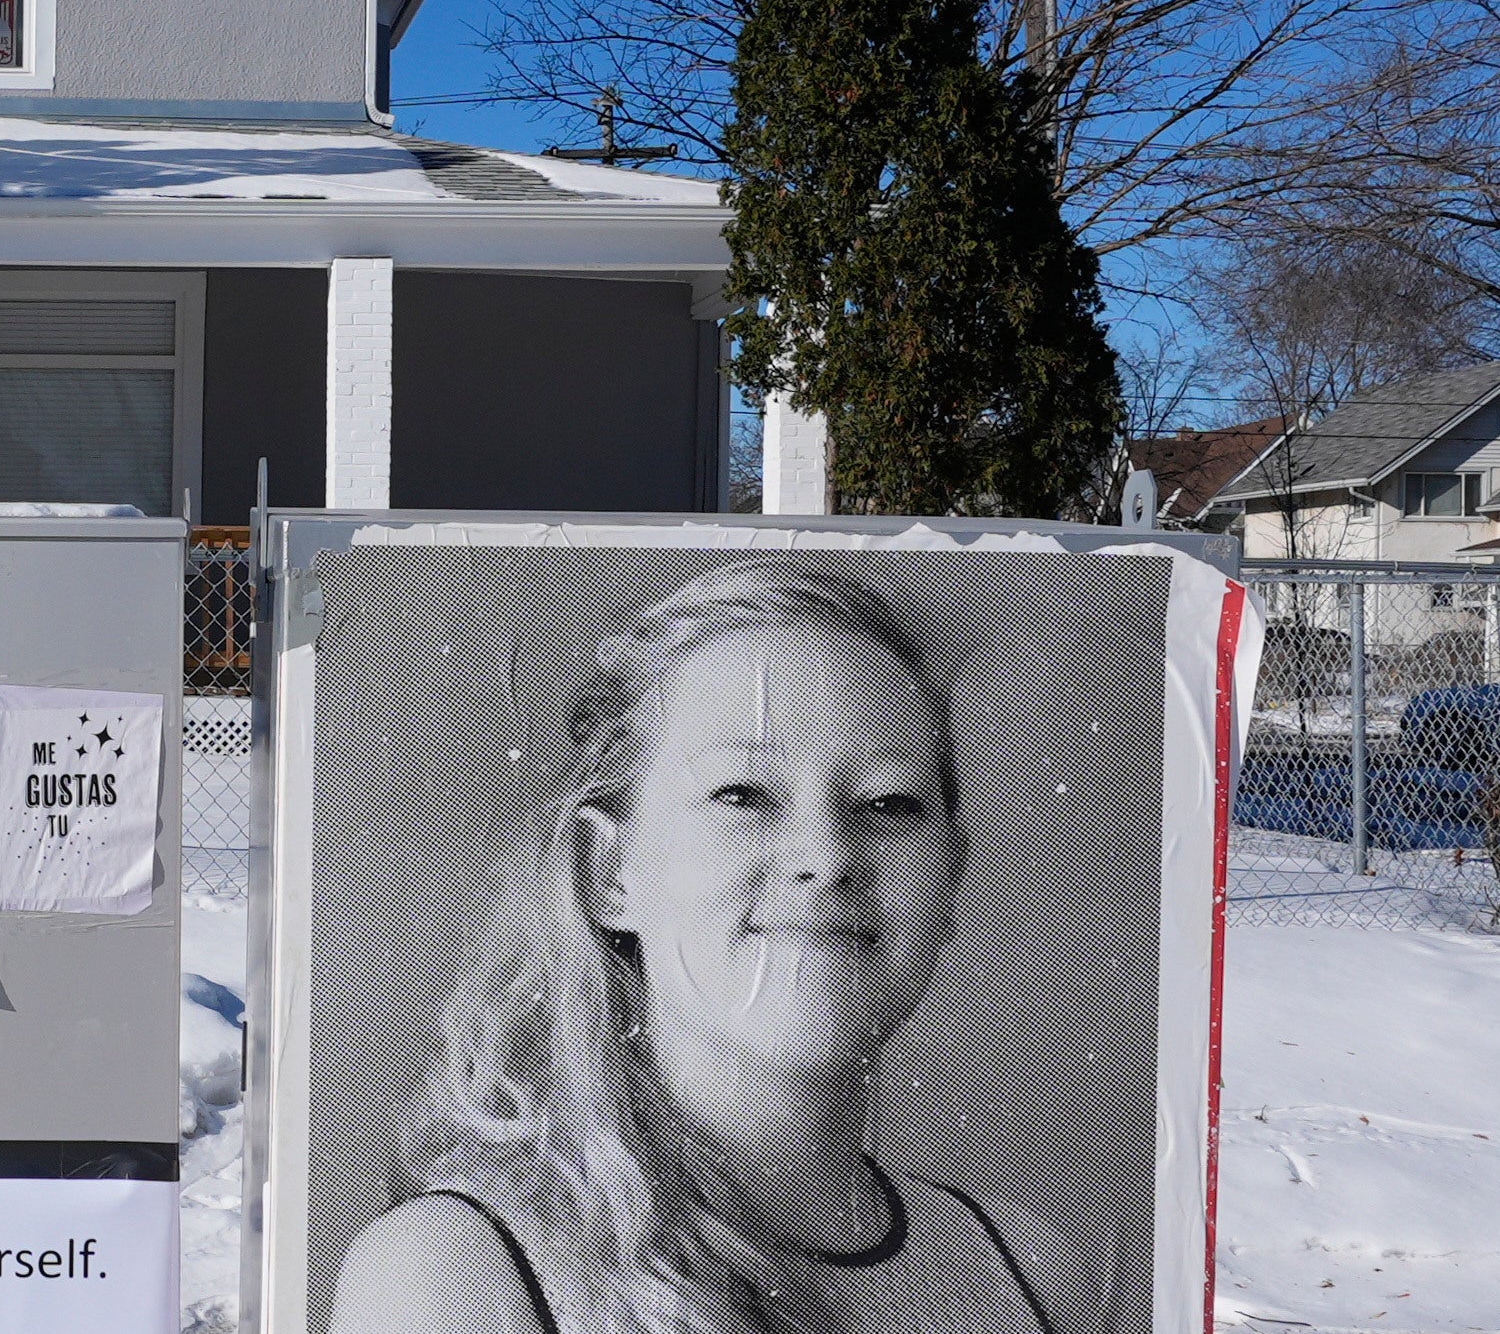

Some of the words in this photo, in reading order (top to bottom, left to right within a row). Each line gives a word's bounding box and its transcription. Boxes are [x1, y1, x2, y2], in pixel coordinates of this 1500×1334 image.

[32, 741, 57, 766] ME
[25, 773, 117, 808] GUSTAS
[46, 814, 69, 838] TU
